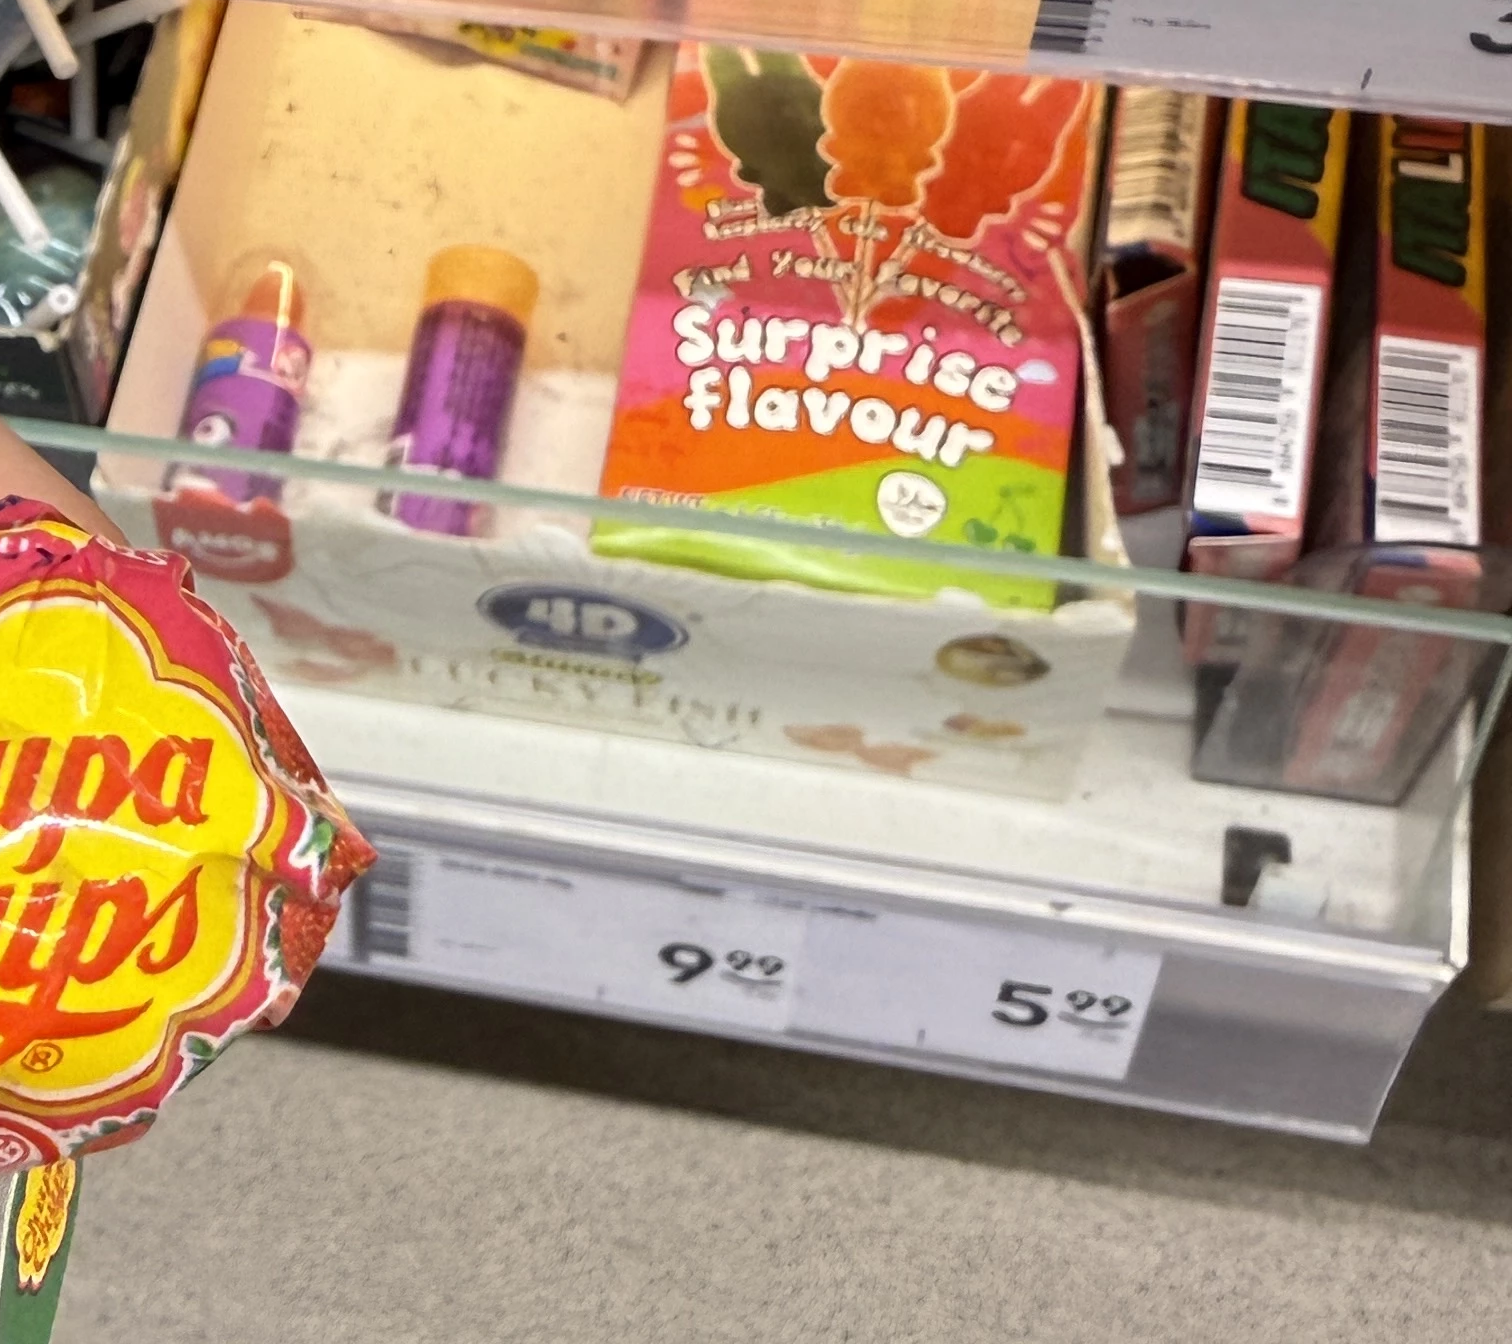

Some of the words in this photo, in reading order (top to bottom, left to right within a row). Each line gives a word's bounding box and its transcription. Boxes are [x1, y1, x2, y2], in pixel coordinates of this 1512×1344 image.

[673, 303, 1019, 413] Surprise
[683, 365, 995, 468] flavour
[524, 595, 639, 637] 4D
